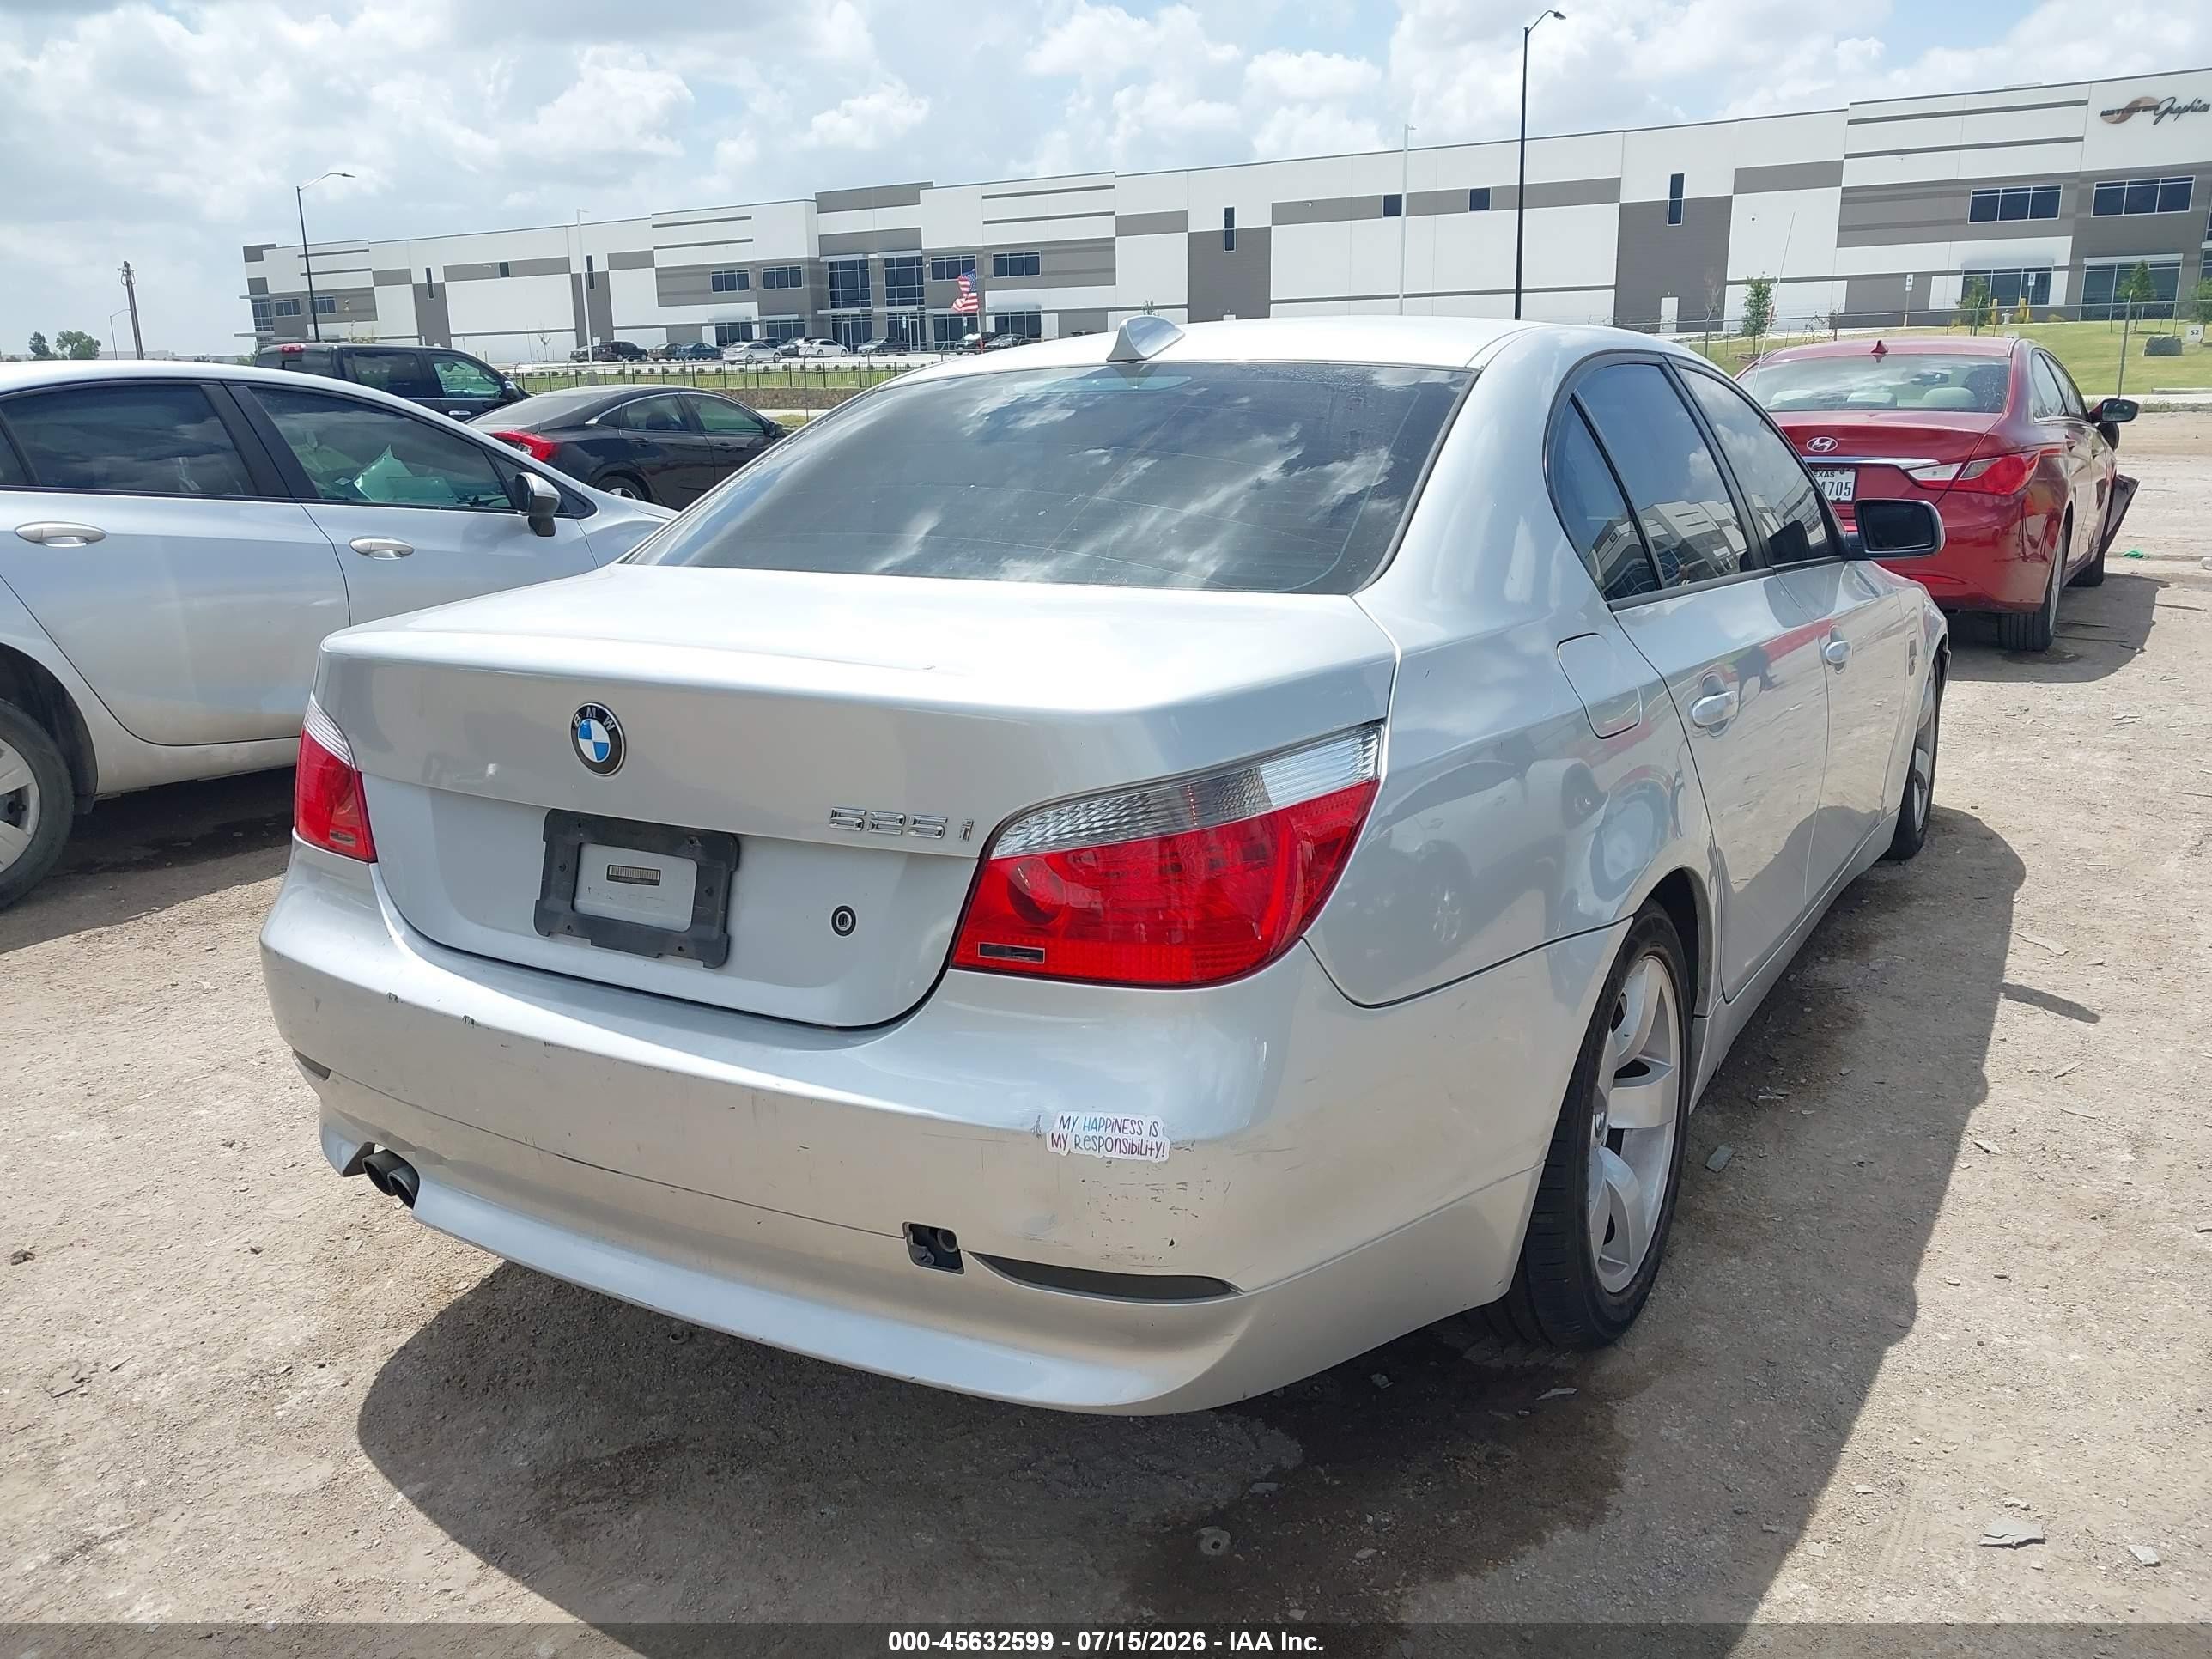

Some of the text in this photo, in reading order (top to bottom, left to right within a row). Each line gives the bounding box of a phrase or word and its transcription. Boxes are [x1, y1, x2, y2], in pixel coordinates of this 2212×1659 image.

[573, 707, 616, 732] BMW
[1059, 1115, 1079, 1133] MY
[1051, 1133, 1068, 1151] MY
